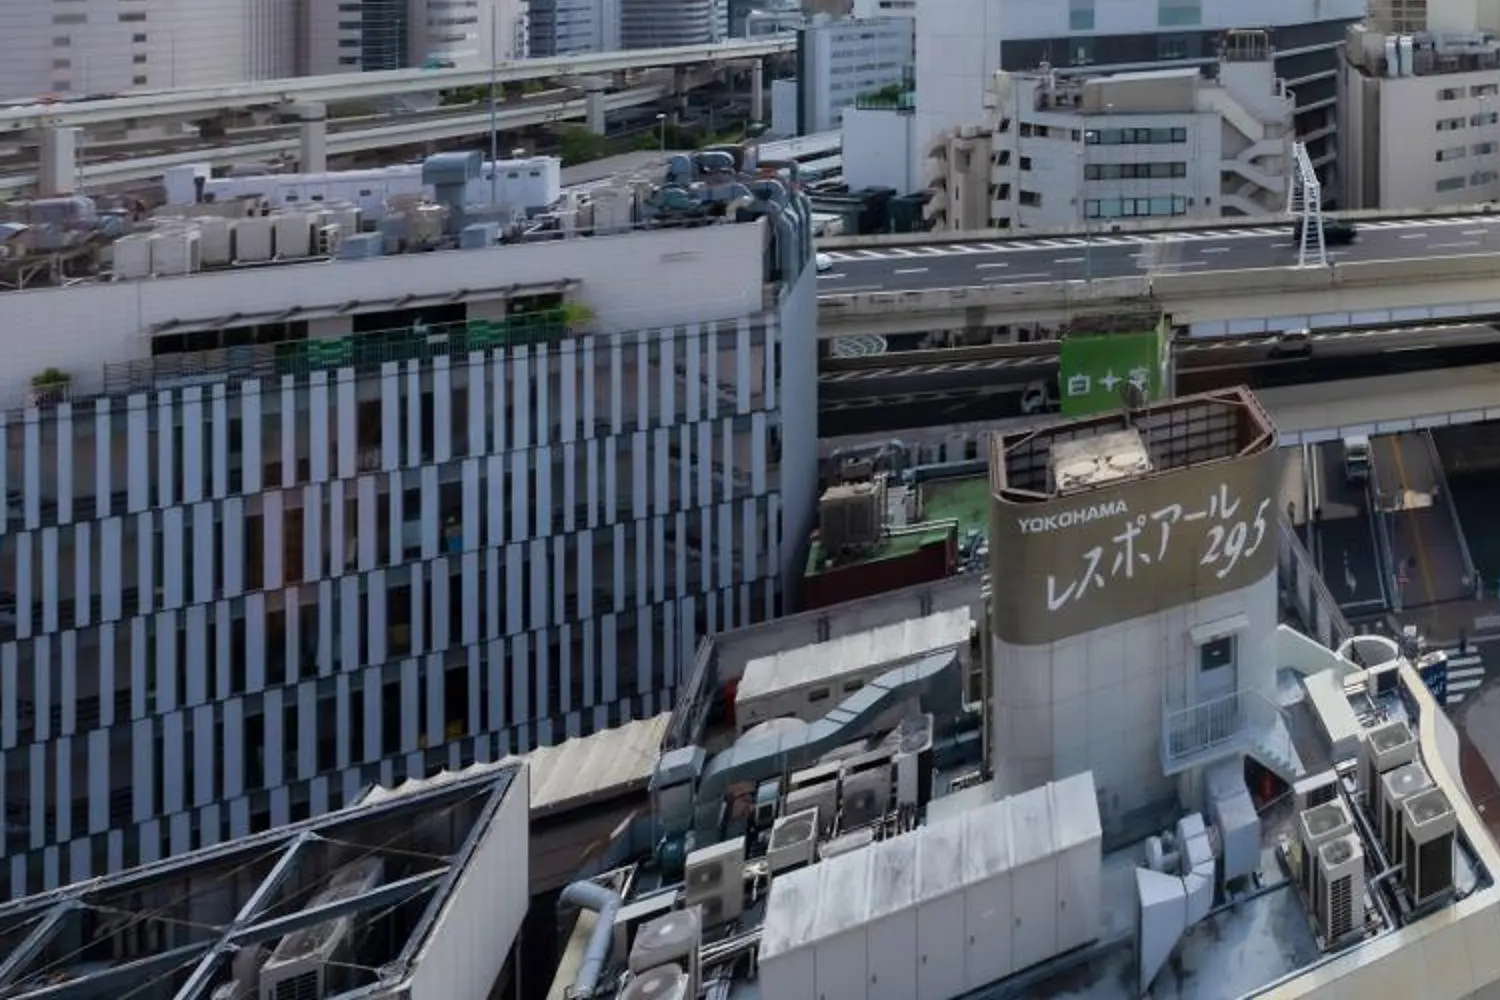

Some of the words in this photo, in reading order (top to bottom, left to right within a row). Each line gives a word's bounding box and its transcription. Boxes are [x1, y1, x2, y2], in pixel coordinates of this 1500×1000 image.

[1018, 499, 1128, 534] YOKOHAMA
[1047, 483, 1241, 611] レスポアール
[1200, 497, 1271, 579] 295
